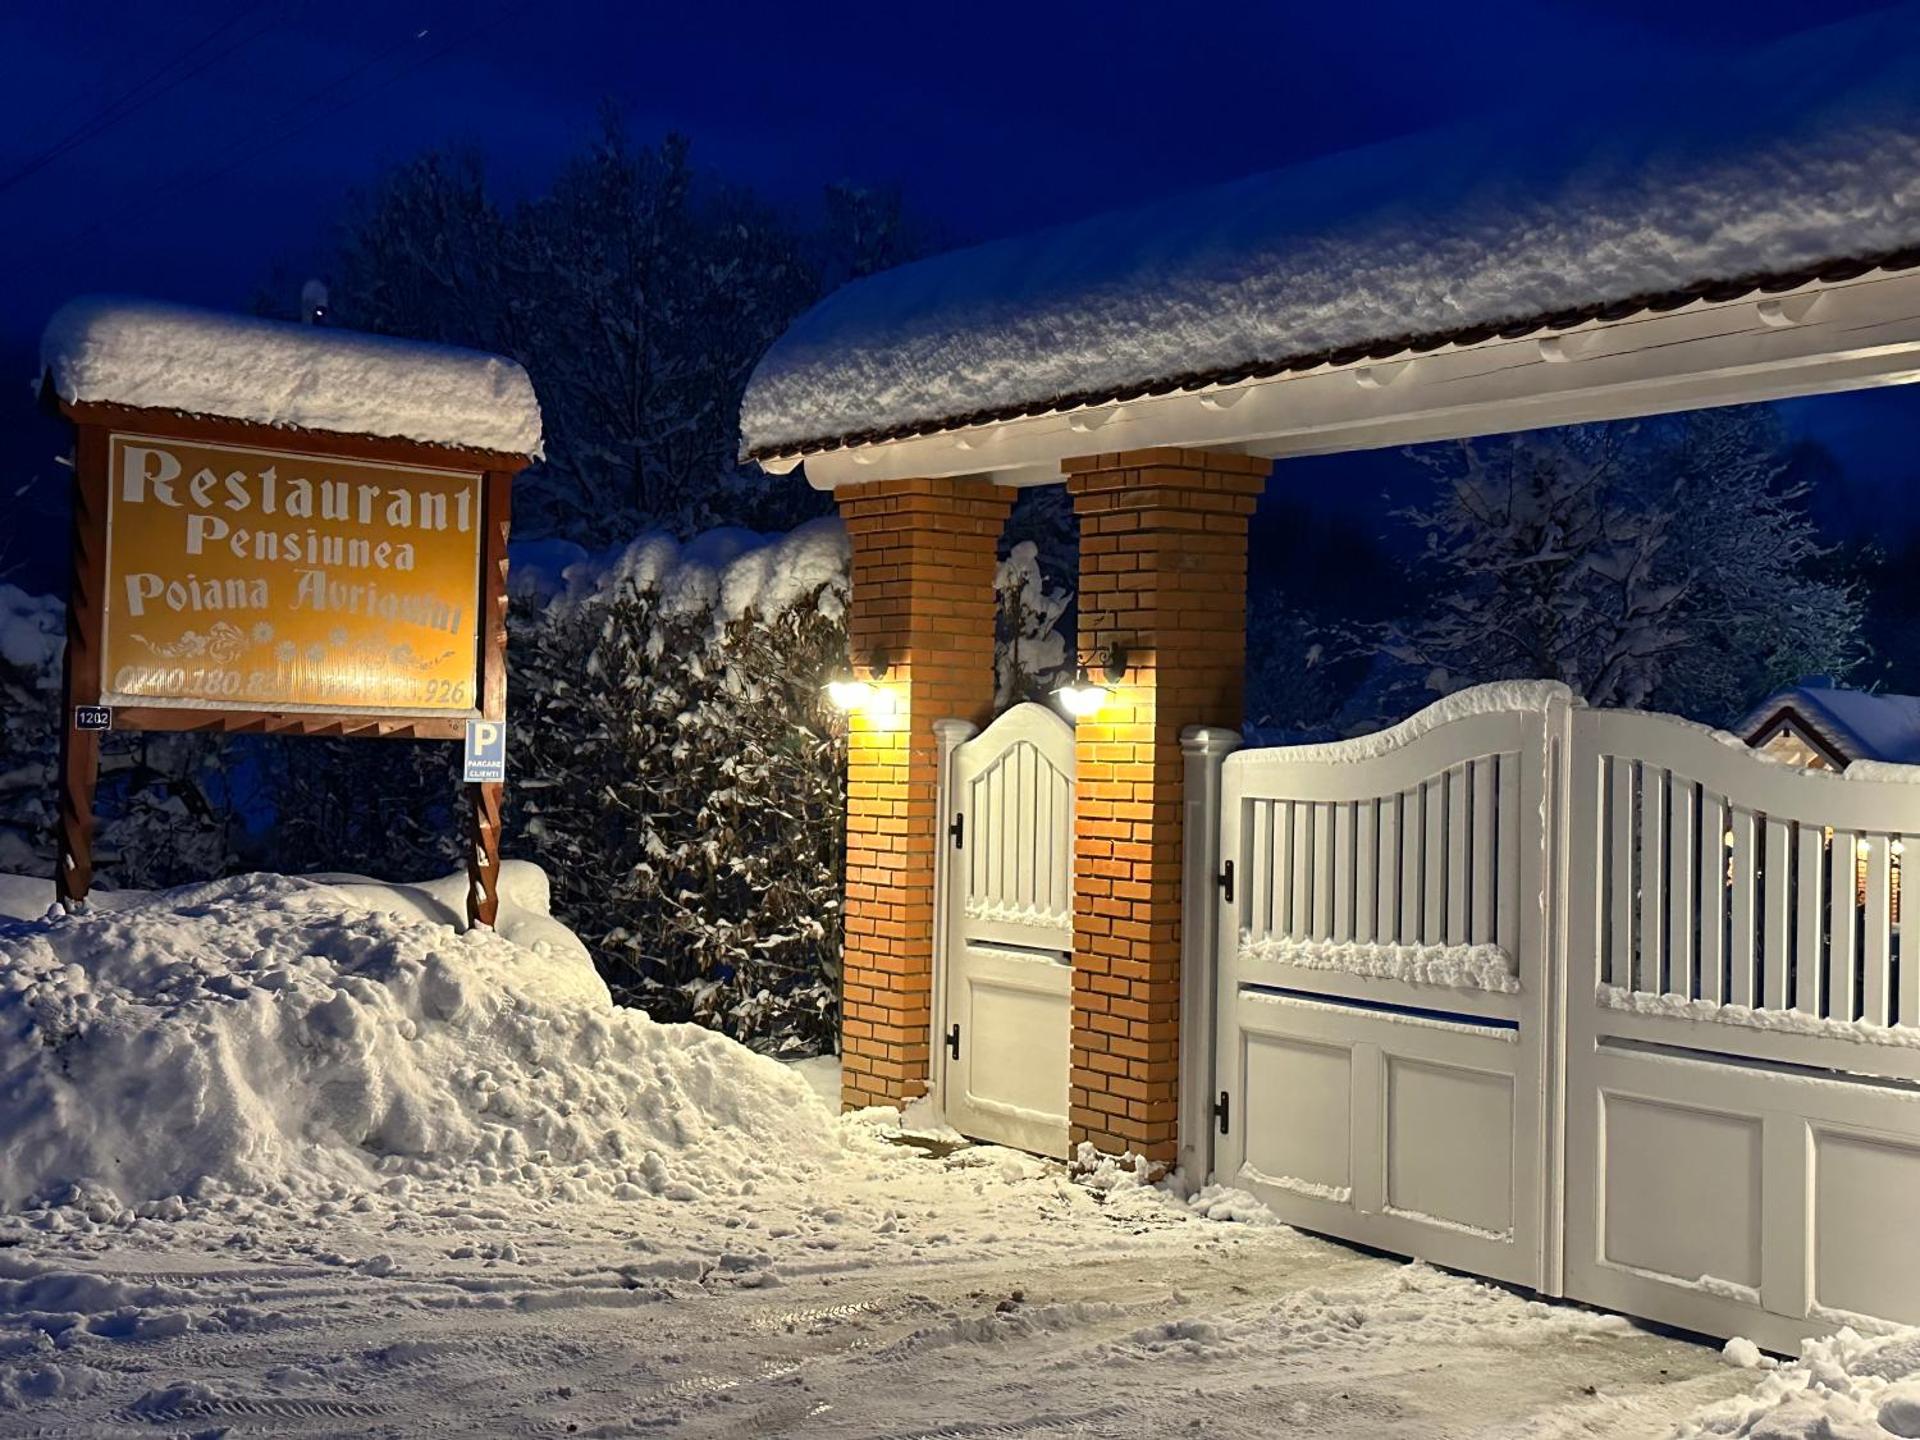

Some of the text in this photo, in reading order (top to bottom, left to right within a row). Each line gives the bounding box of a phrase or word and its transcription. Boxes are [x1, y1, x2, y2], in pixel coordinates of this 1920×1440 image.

[122, 445, 472, 533] Restaurant
[186, 513, 415, 572] Pensiunea
[125, 572, 269, 617] Poiana
[80, 712, 108, 724] 1202
[475, 723, 497, 755] P
